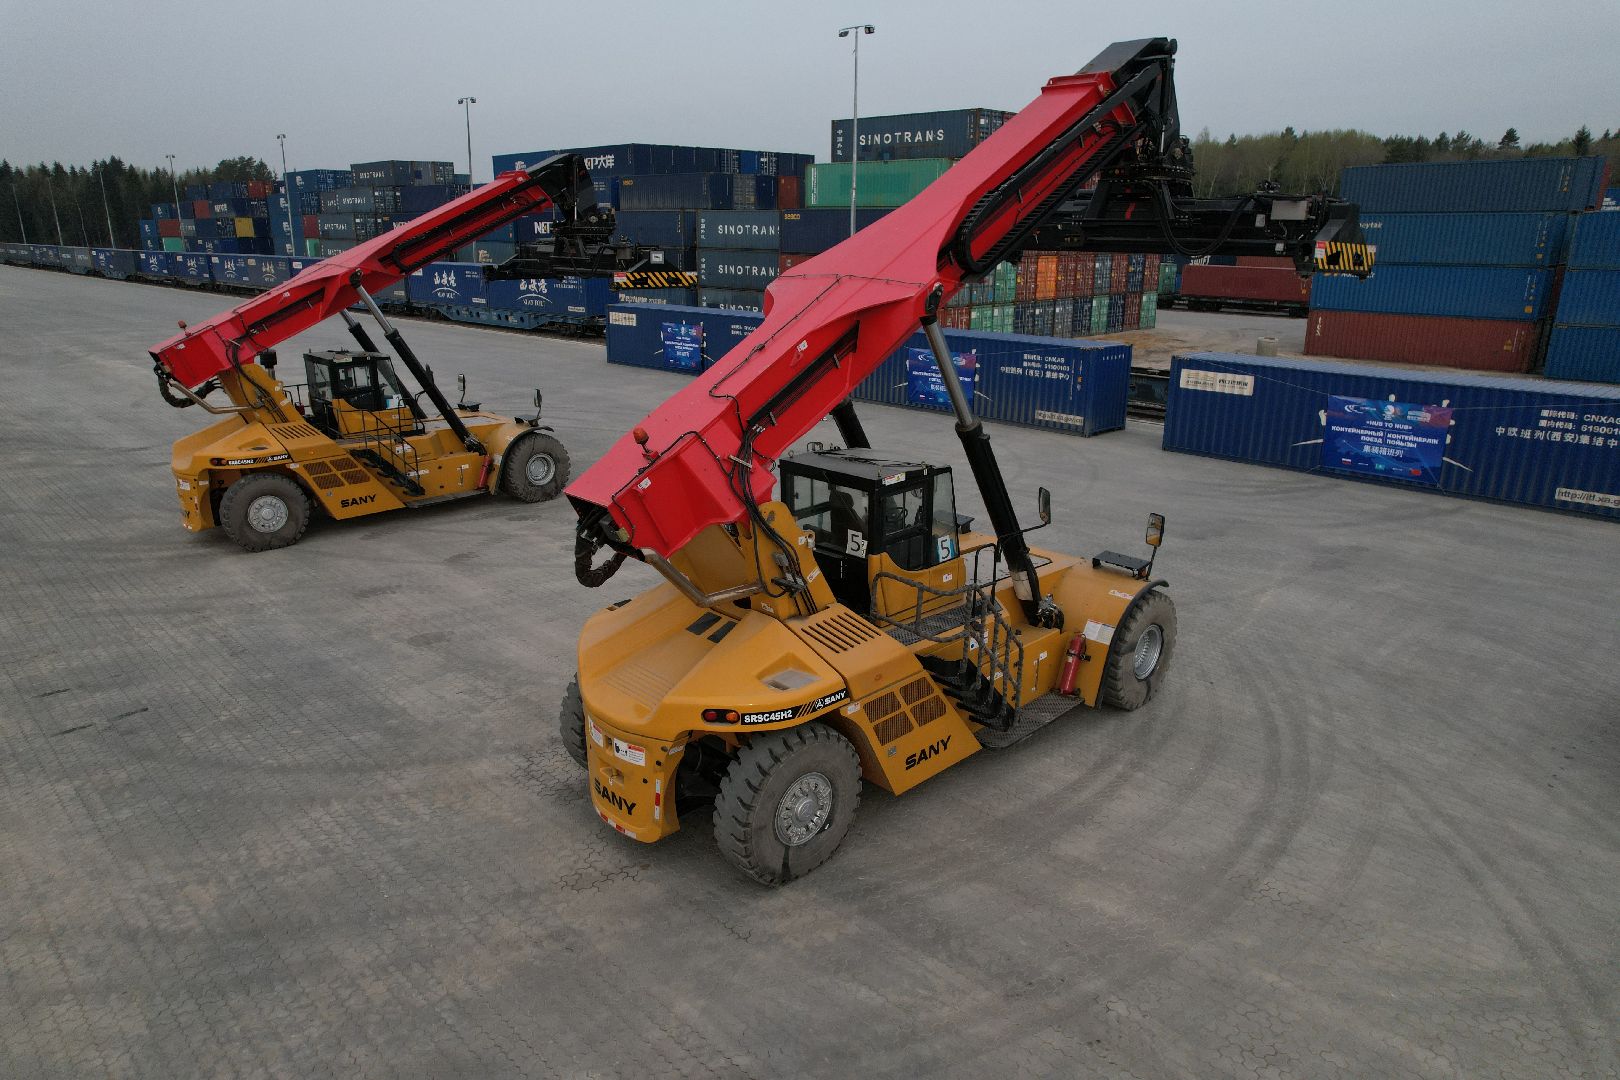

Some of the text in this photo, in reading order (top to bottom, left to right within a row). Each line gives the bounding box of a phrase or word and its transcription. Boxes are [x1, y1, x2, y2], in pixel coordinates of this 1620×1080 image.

[859, 129, 944, 146] SINOTRANS
[1331, 425, 1384, 437] КОНТЕЙНЕРНЫЙ
[1581, 424, 1620, 436] 619001
[1360, 436, 1383, 444] ПОЕЗД
[340, 493, 377, 508] SANY
[850, 533, 861, 552] 5
[941, 538, 951, 560] 5
[744, 690, 846, 723] SRSC45H2 SANY
[905, 734, 952, 771] SANY
[594, 777, 637, 816] SANY
